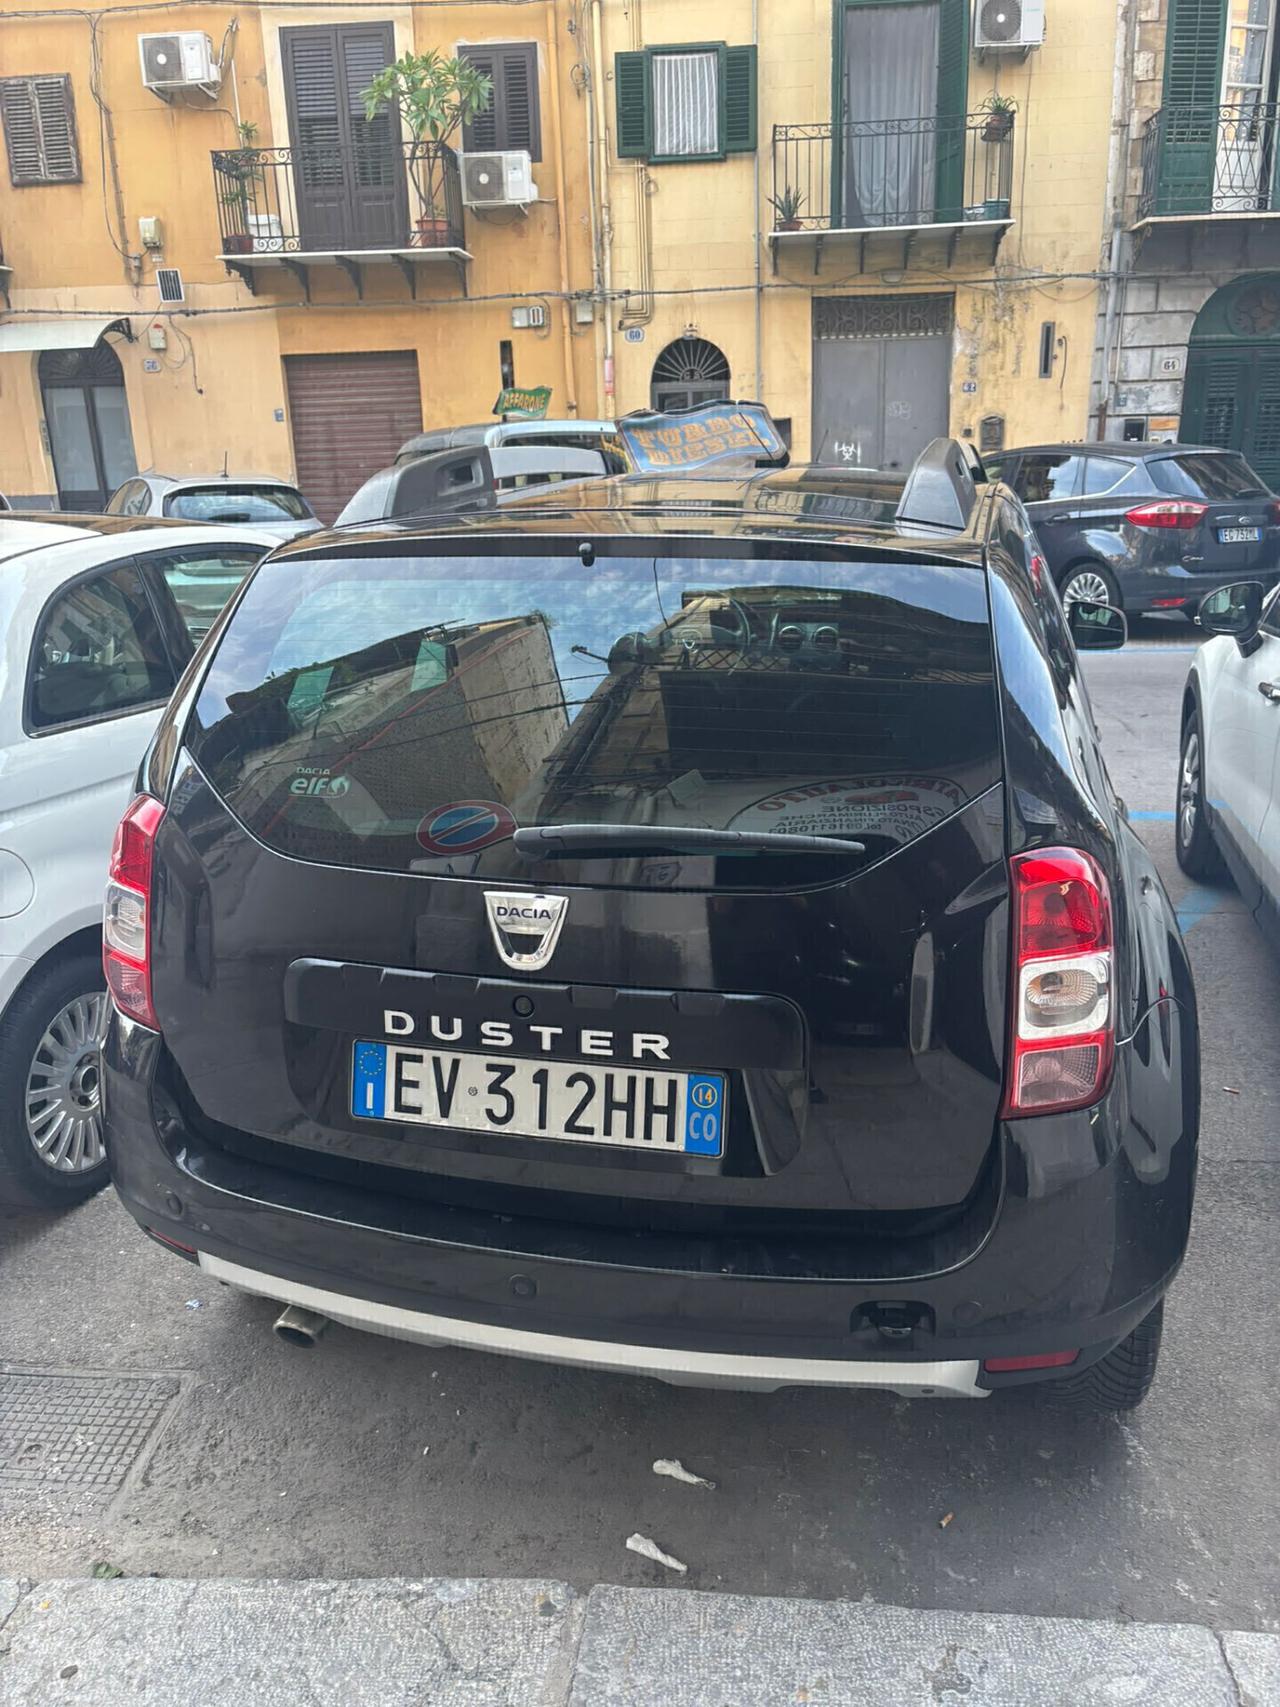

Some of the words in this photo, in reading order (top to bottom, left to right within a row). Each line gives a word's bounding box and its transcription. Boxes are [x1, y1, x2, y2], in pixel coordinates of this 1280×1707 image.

[296, 766, 331, 775] DACIA
[290, 776, 330, 795] elf
[496, 905, 553, 921] DACIA
[383, 1009, 671, 1061] DUSTER
[697, 1086, 713, 1104] 14
[689, 1110, 717, 1143] CO
